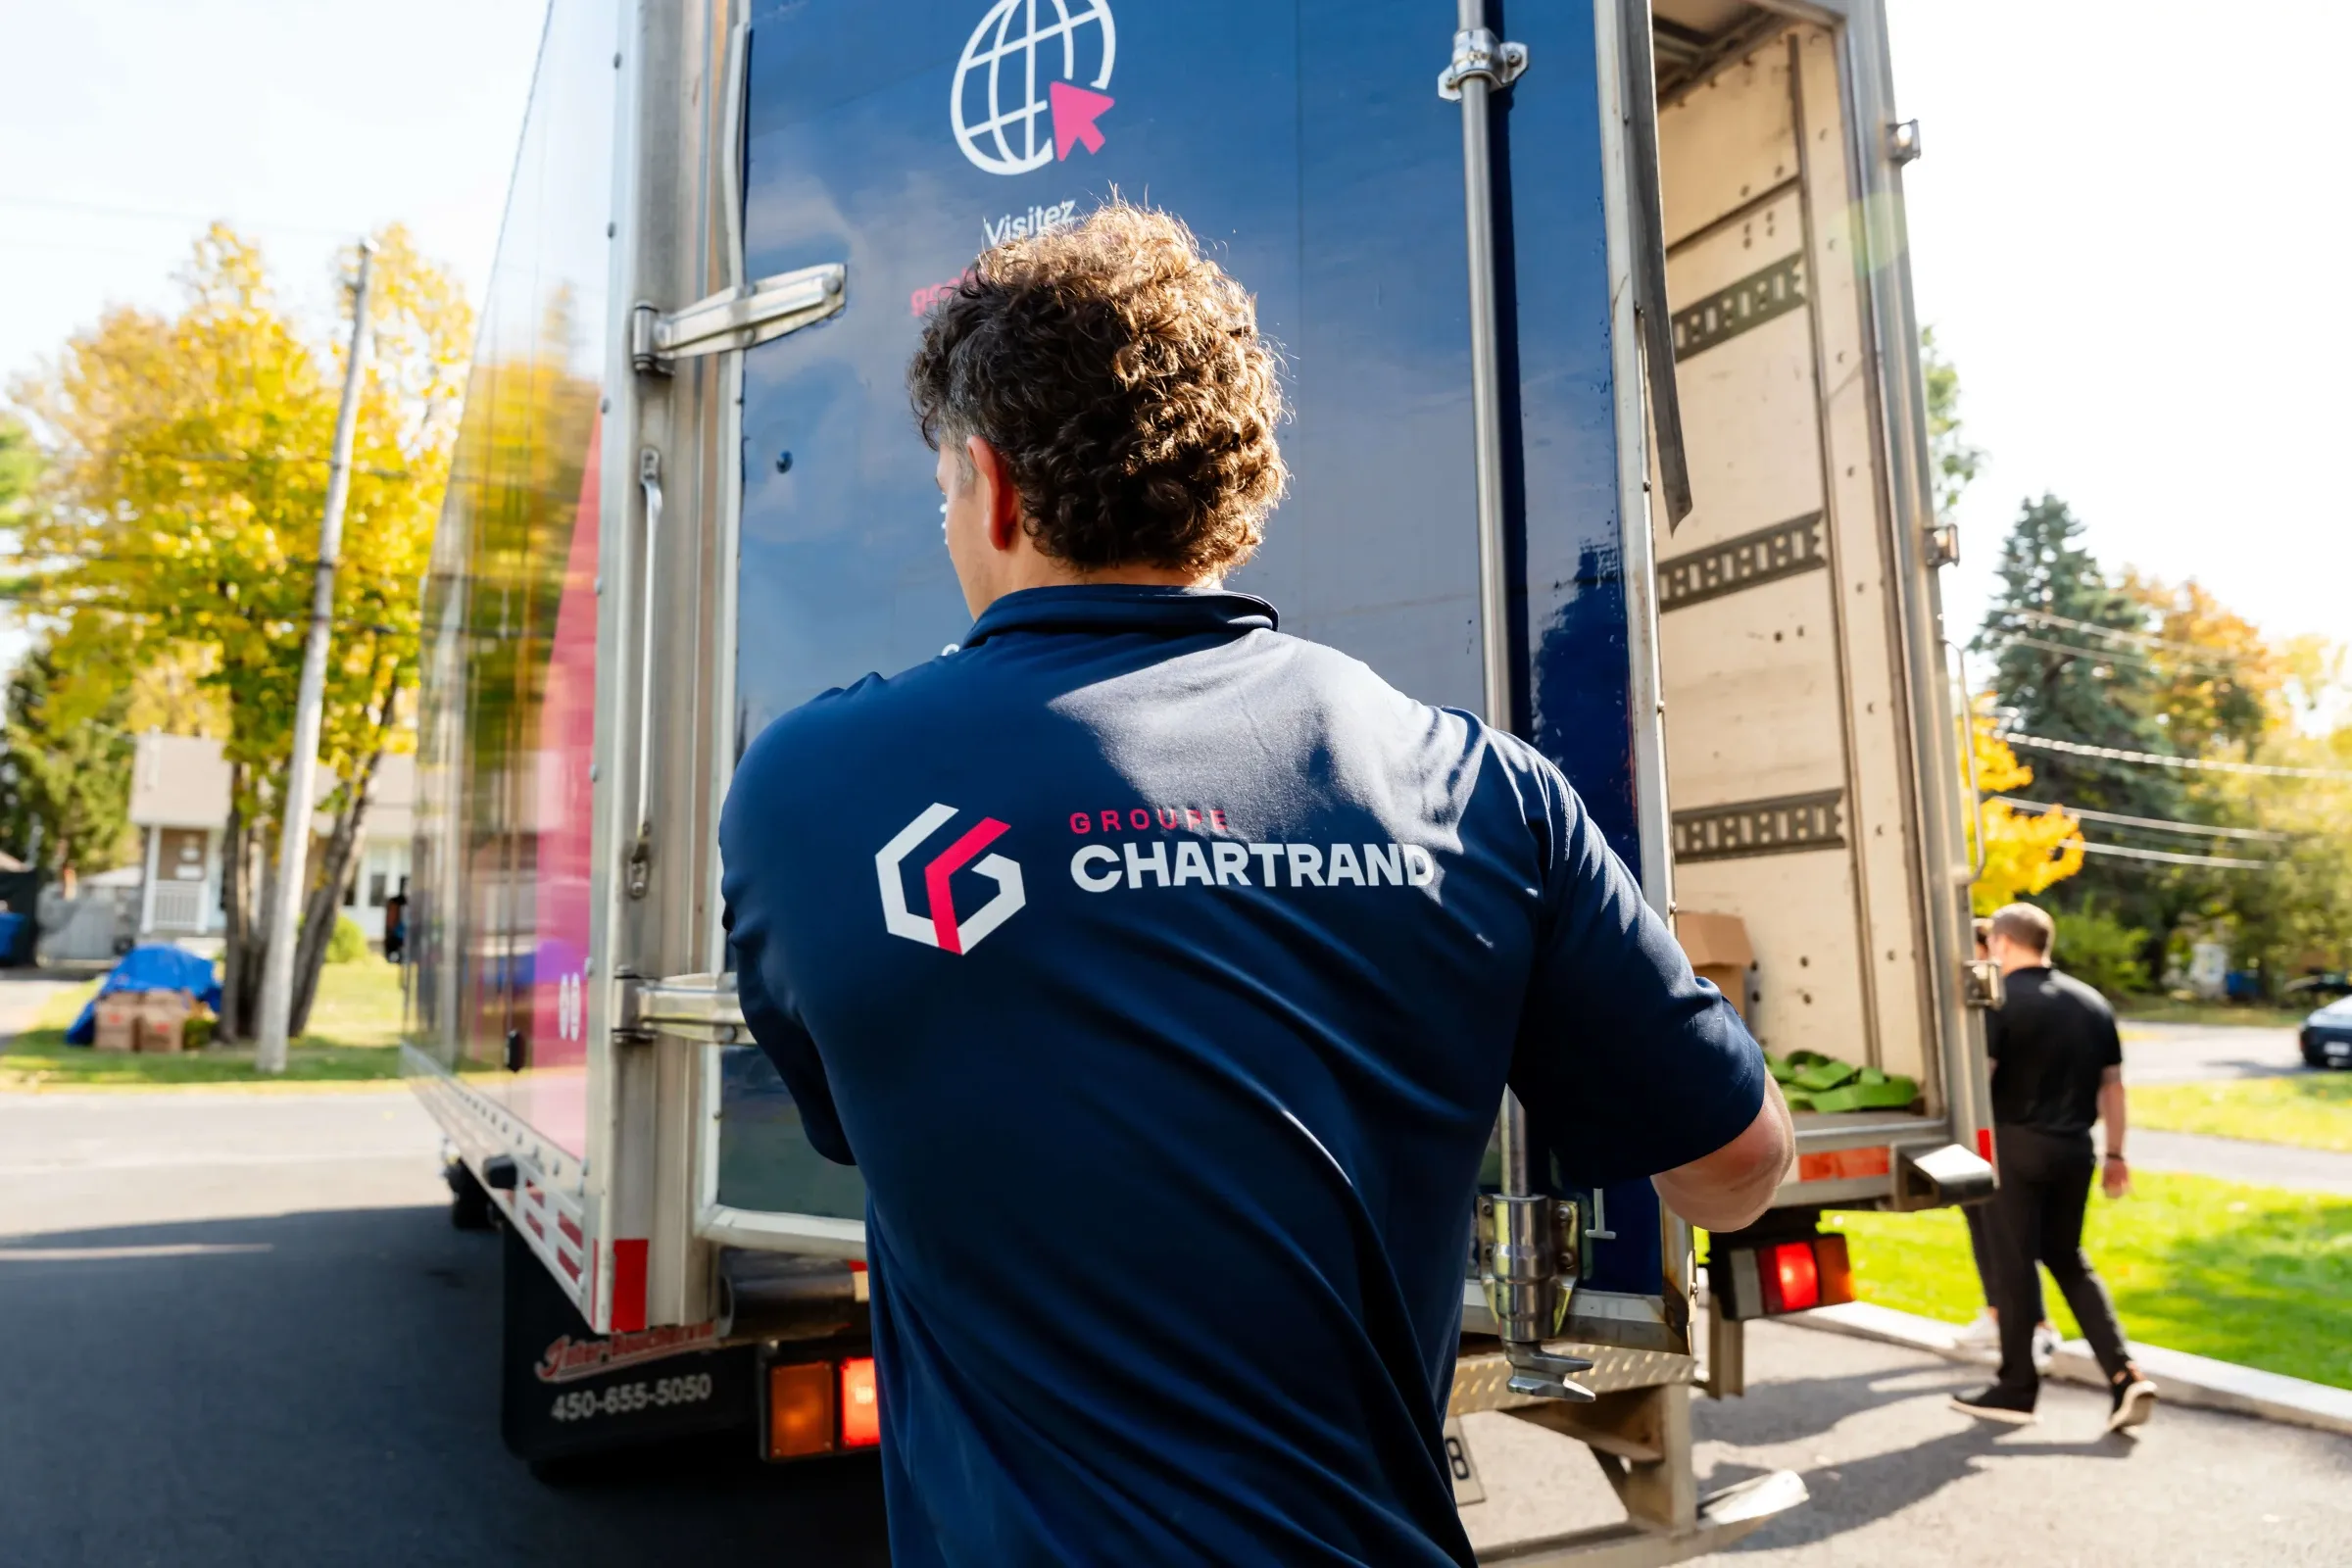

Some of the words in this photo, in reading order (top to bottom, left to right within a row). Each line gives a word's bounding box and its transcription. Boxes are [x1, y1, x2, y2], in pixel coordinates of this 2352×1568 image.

[984, 200, 1076, 246] Visitez
[1069, 808, 1228, 834] GROUPE
[1070, 841, 1435, 893] CHARTRAND
[552, 1373, 712, 1421] 450-655-5050
